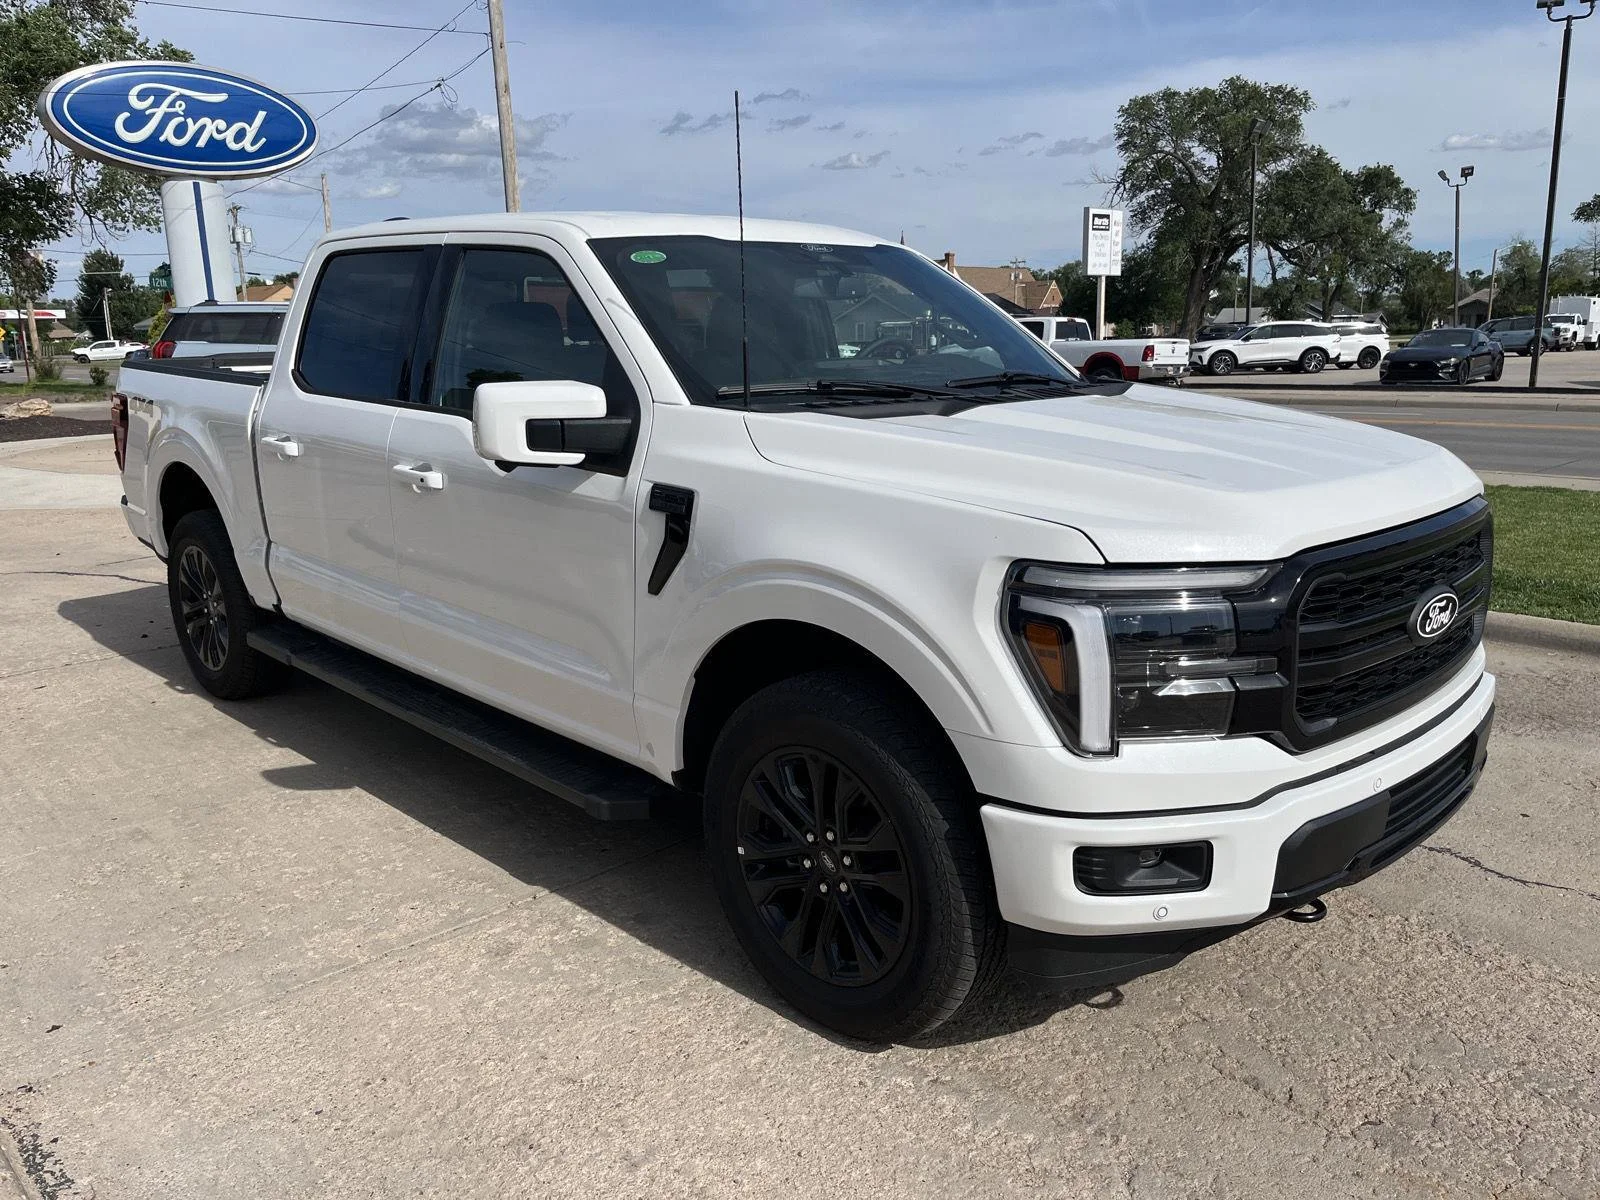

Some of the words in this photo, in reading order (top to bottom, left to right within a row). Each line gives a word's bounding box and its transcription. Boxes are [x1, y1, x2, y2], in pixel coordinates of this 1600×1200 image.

[114, 82, 268, 153] Ford
[152, 277, 168, 287] 12th
[1425, 599, 1453, 633] Ford
